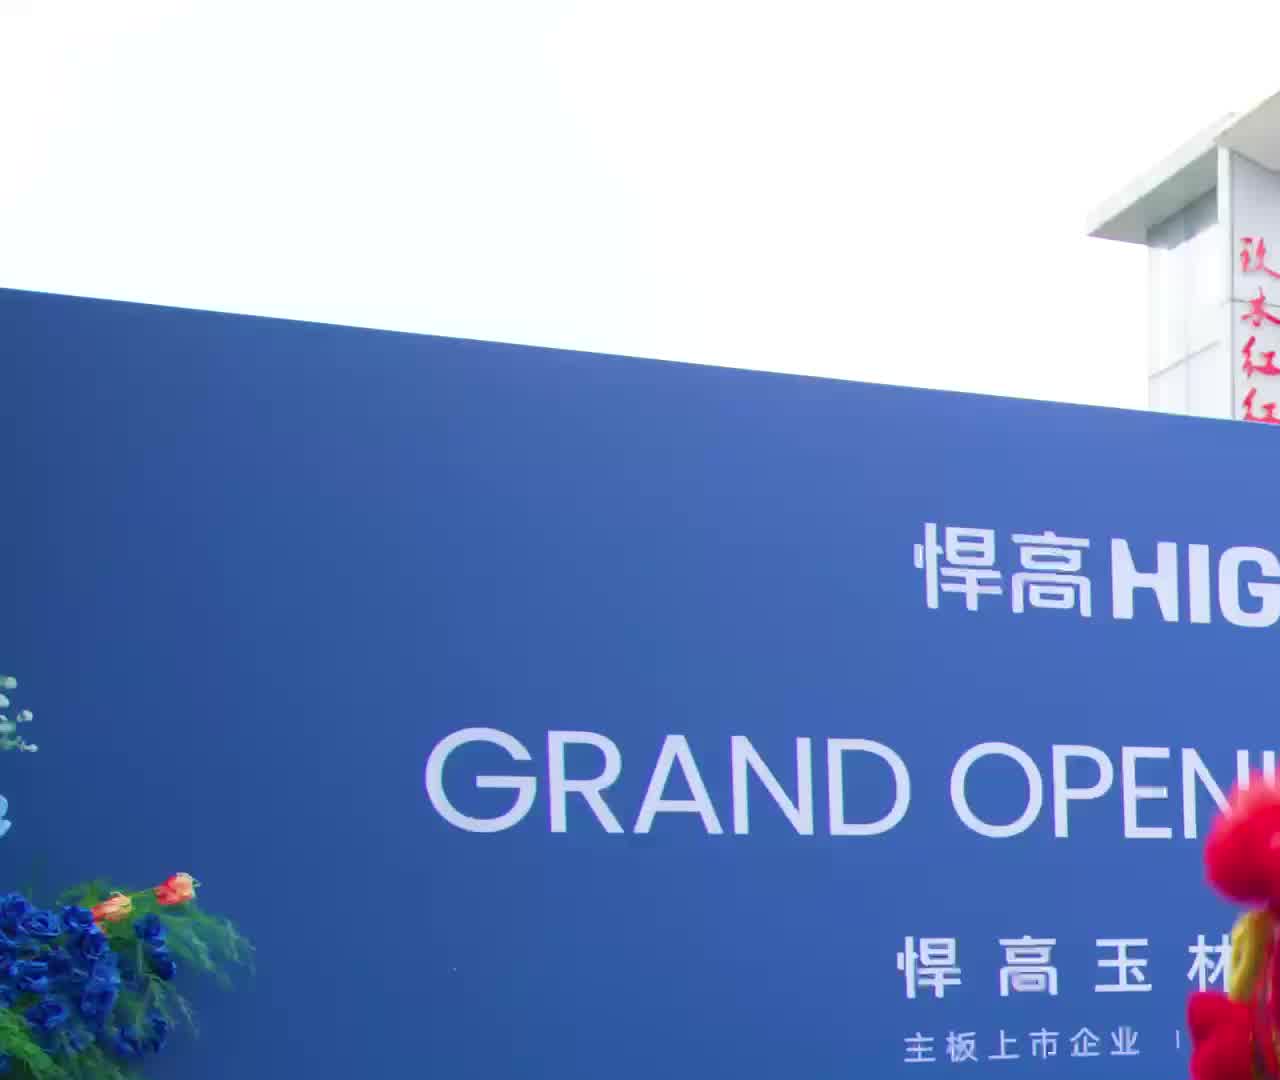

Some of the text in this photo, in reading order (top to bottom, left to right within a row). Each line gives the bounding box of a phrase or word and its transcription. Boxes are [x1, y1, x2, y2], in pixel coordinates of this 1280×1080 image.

[913, 522, 1092, 618] 悍高
[424, 727, 912, 837] GRAND
[904, 1026, 1141, 1064] 主板上市企业
